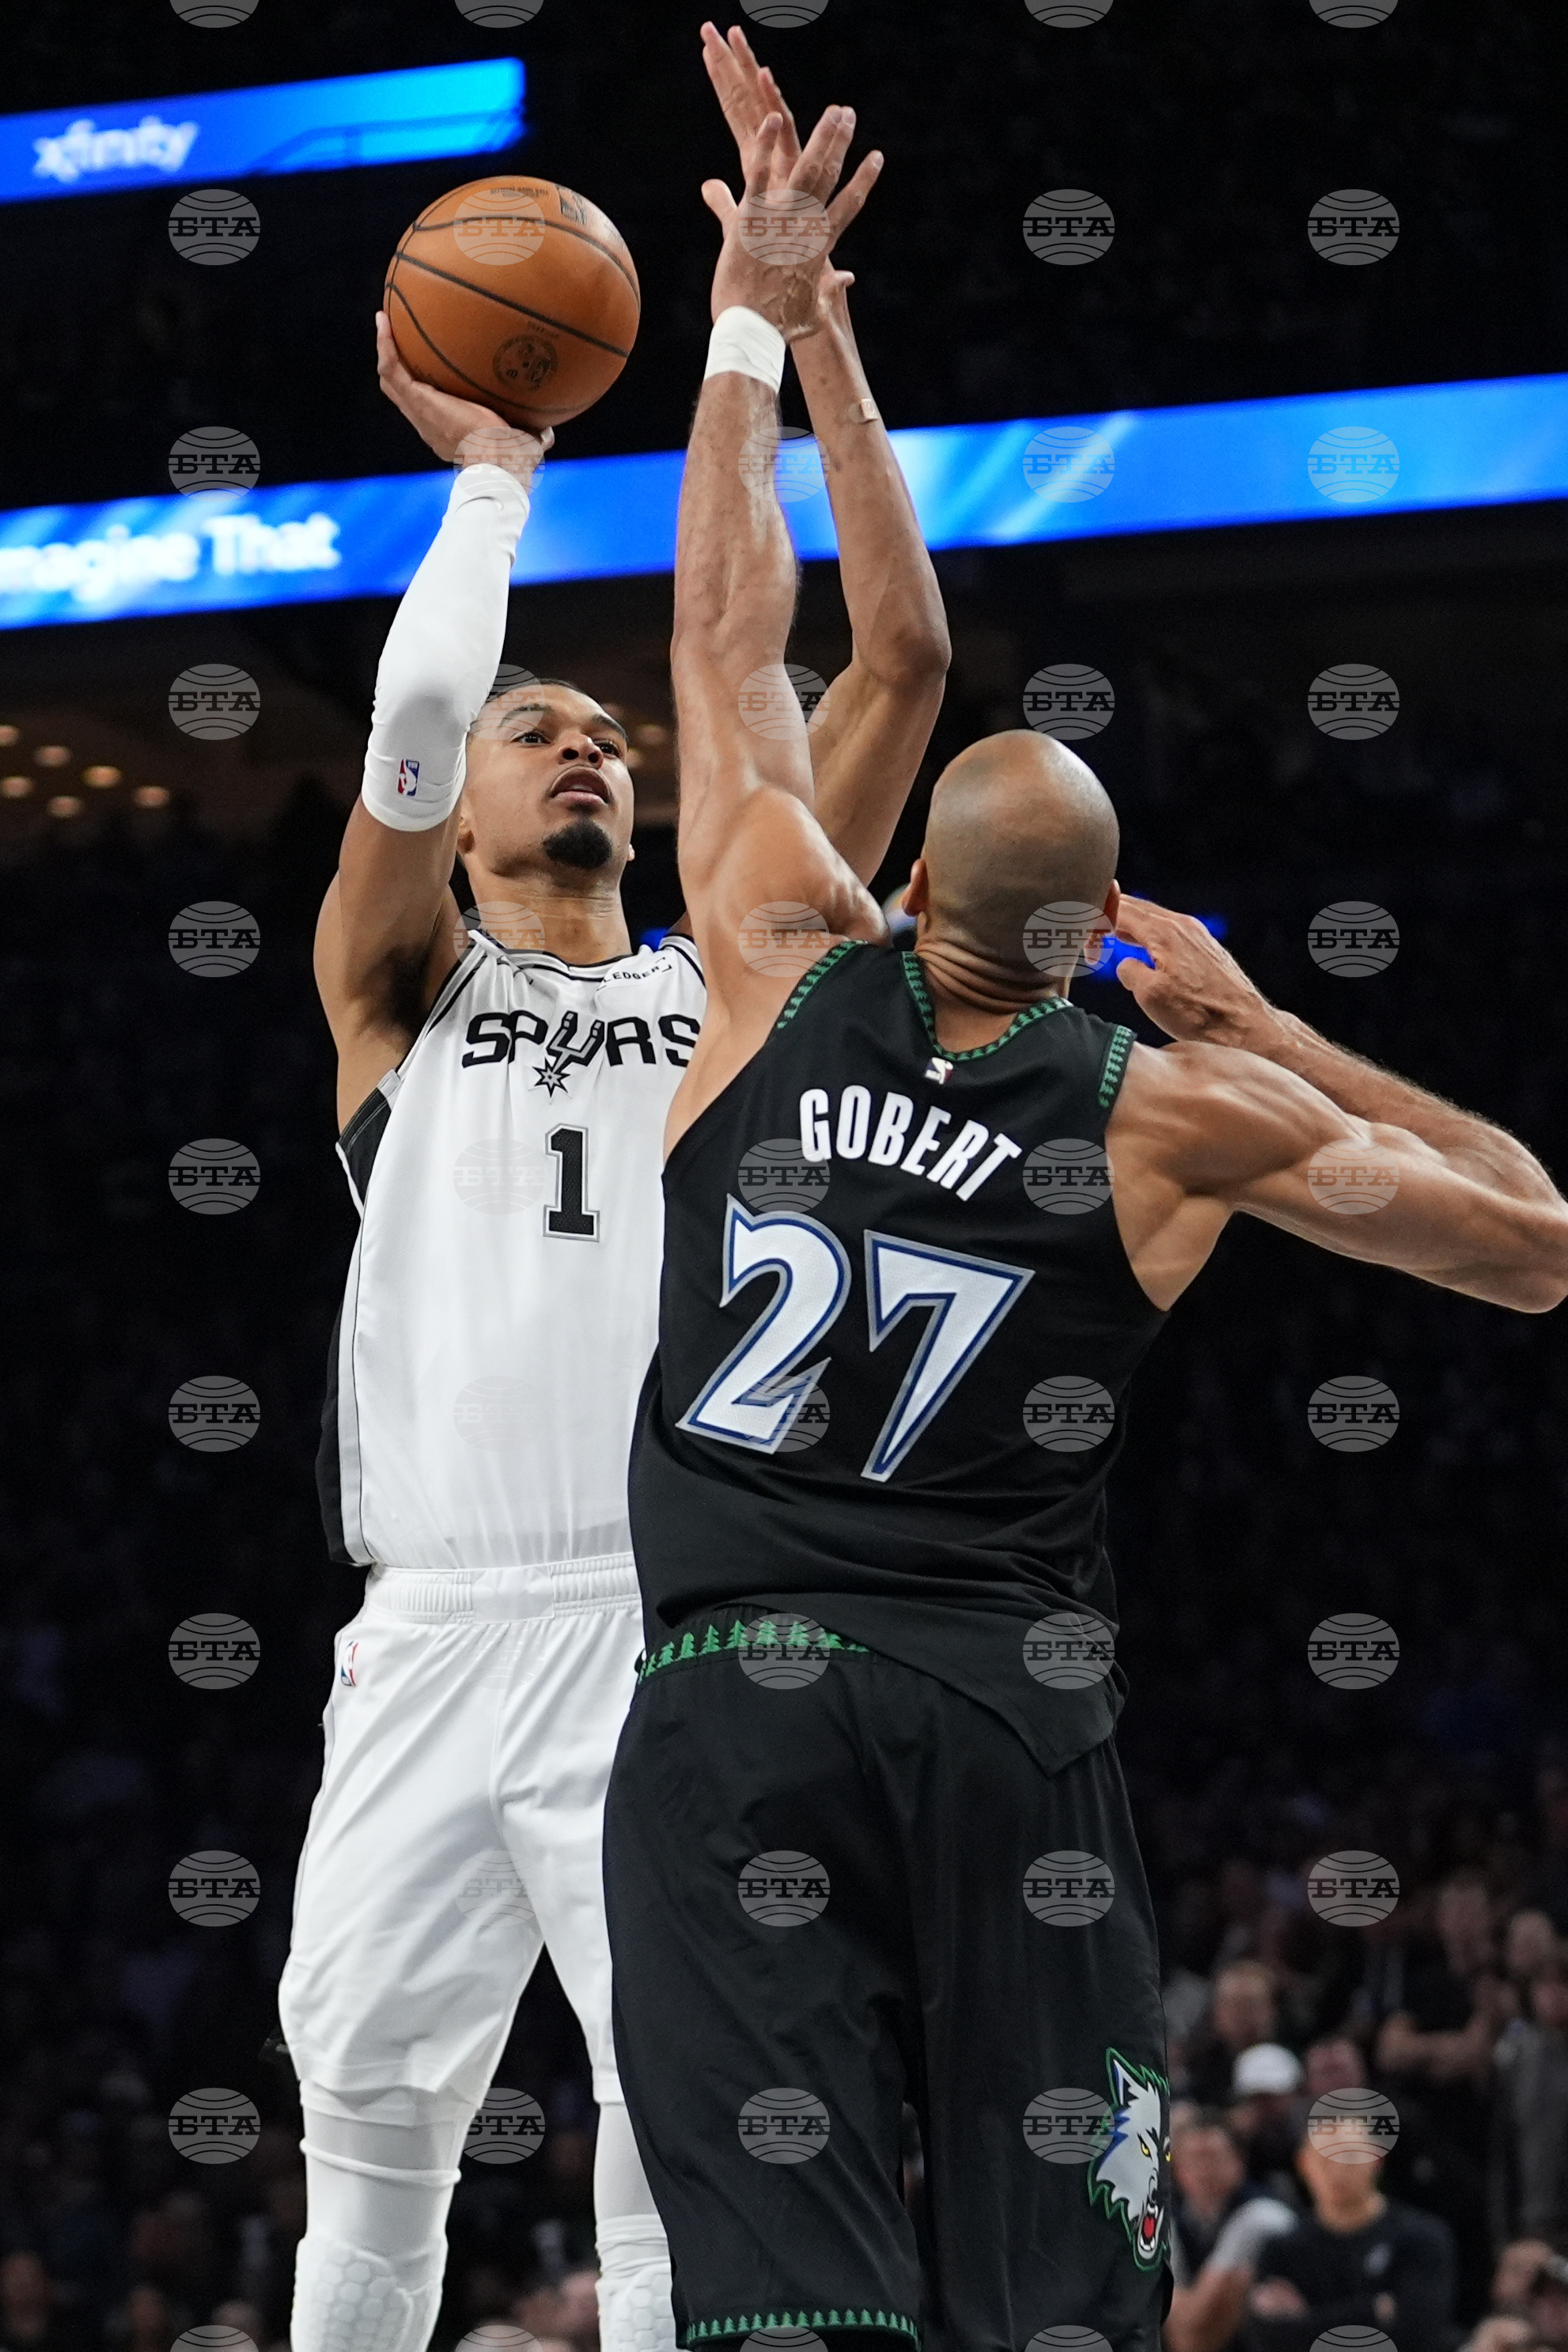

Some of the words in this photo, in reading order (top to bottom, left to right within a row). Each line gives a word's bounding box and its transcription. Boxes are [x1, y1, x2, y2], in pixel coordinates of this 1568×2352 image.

[461, 1009, 701, 1068] SPURS
[543, 1123, 600, 1242] 1
[800, 1085, 1022, 1201] GOBERT
[676, 1193, 1036, 1482] 27
